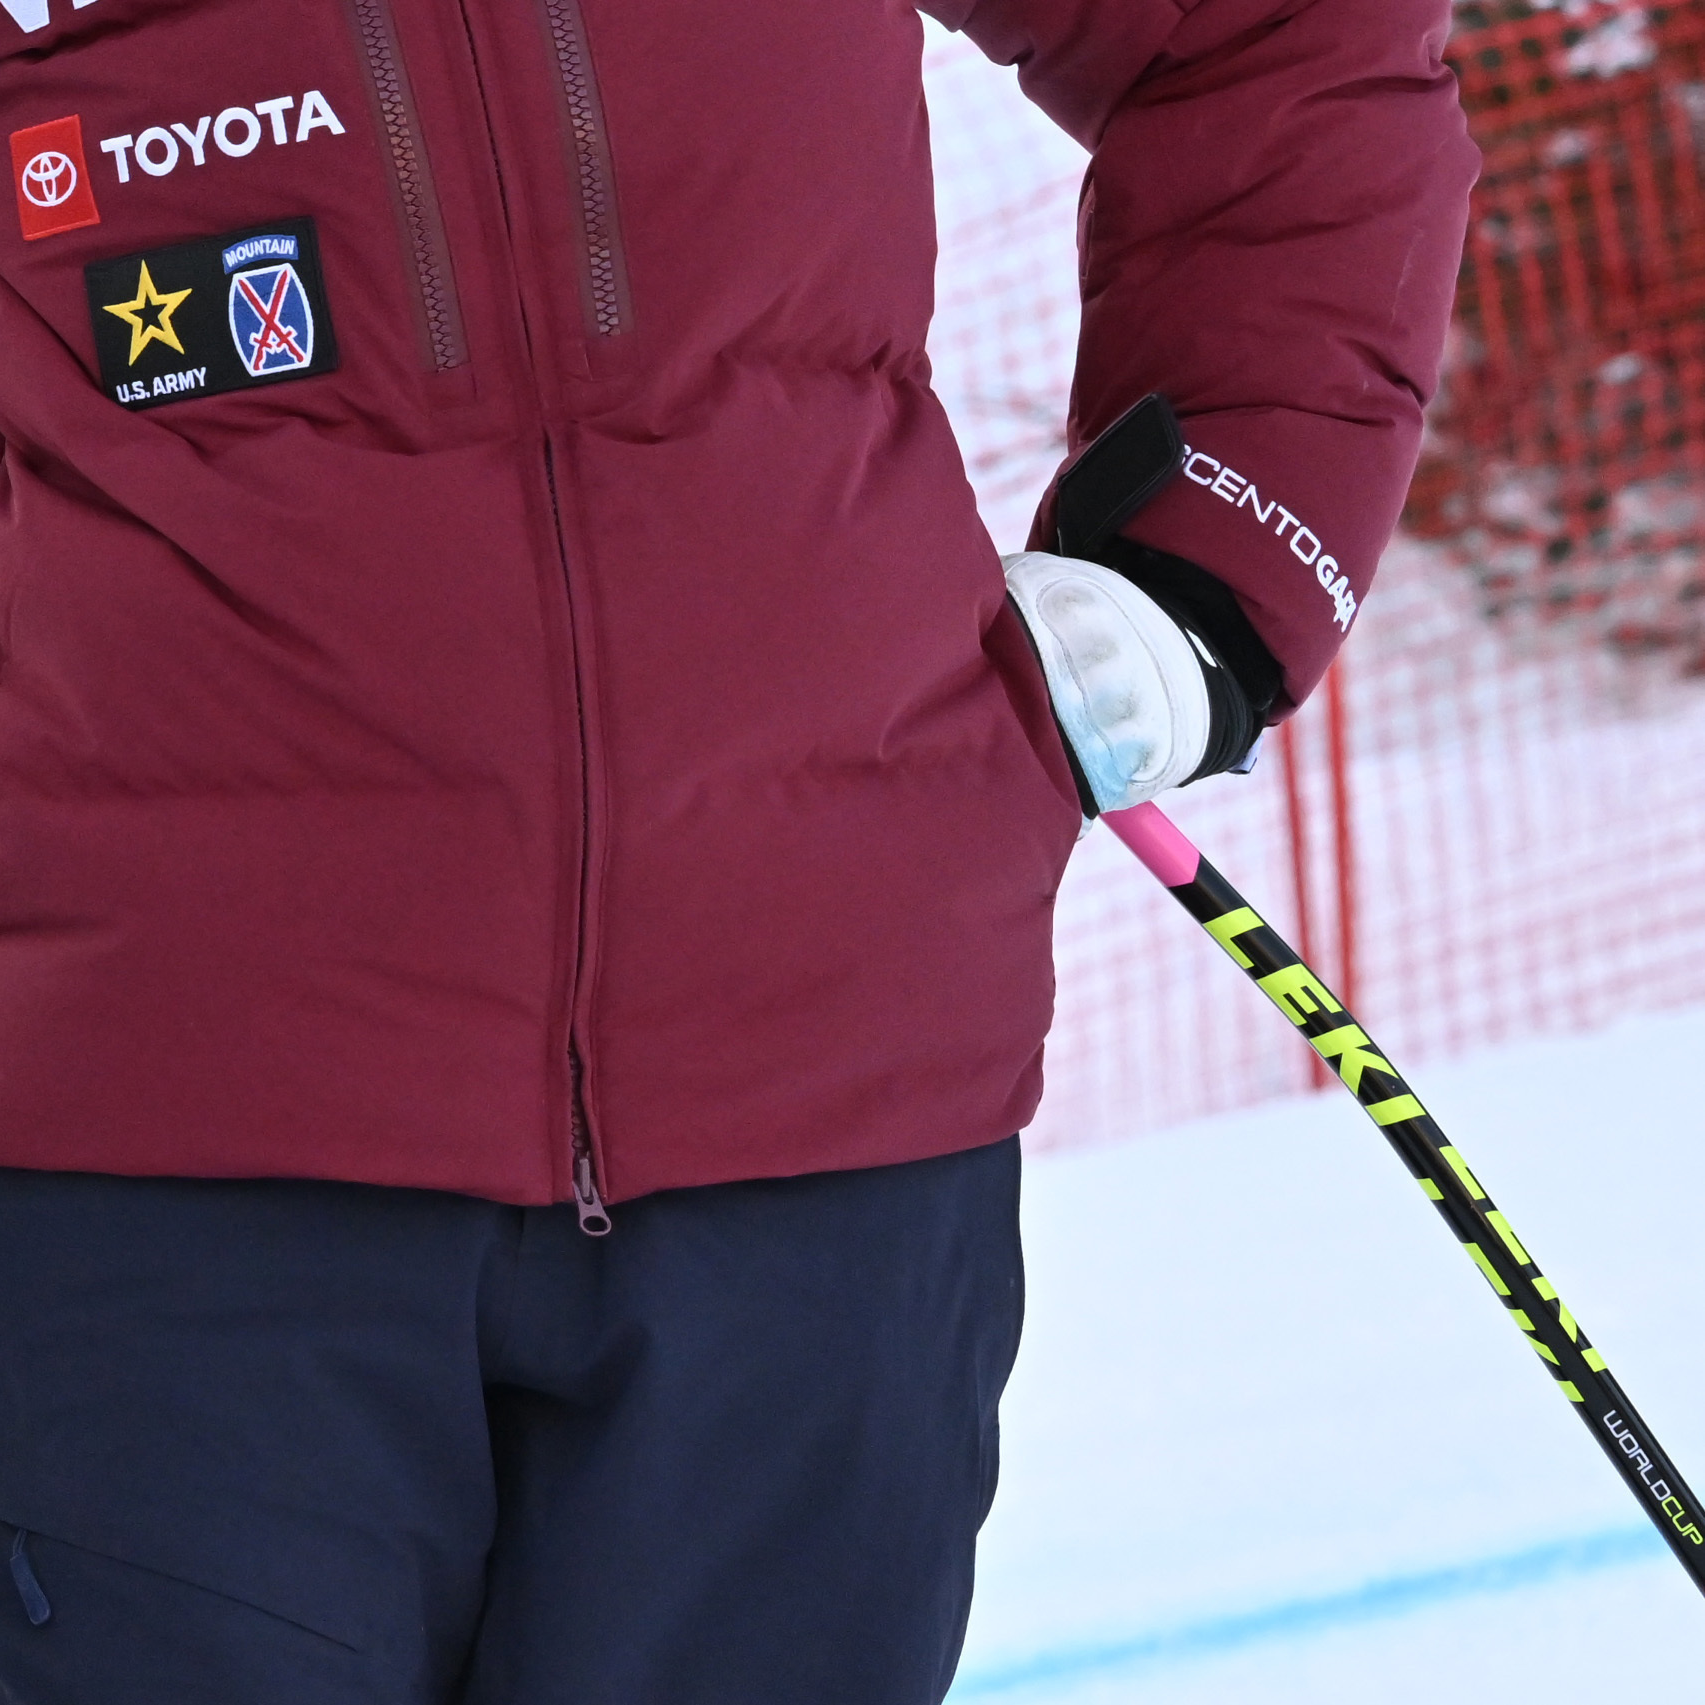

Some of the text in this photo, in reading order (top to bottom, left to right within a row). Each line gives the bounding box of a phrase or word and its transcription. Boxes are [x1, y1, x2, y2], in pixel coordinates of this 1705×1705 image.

[100, 89, 345, 184] TOYOTA
[225, 239, 295, 268] MOUNTAIN
[116, 366, 207, 403] U.S. ARMY
[1202, 906, 1427, 1127] LEKI
